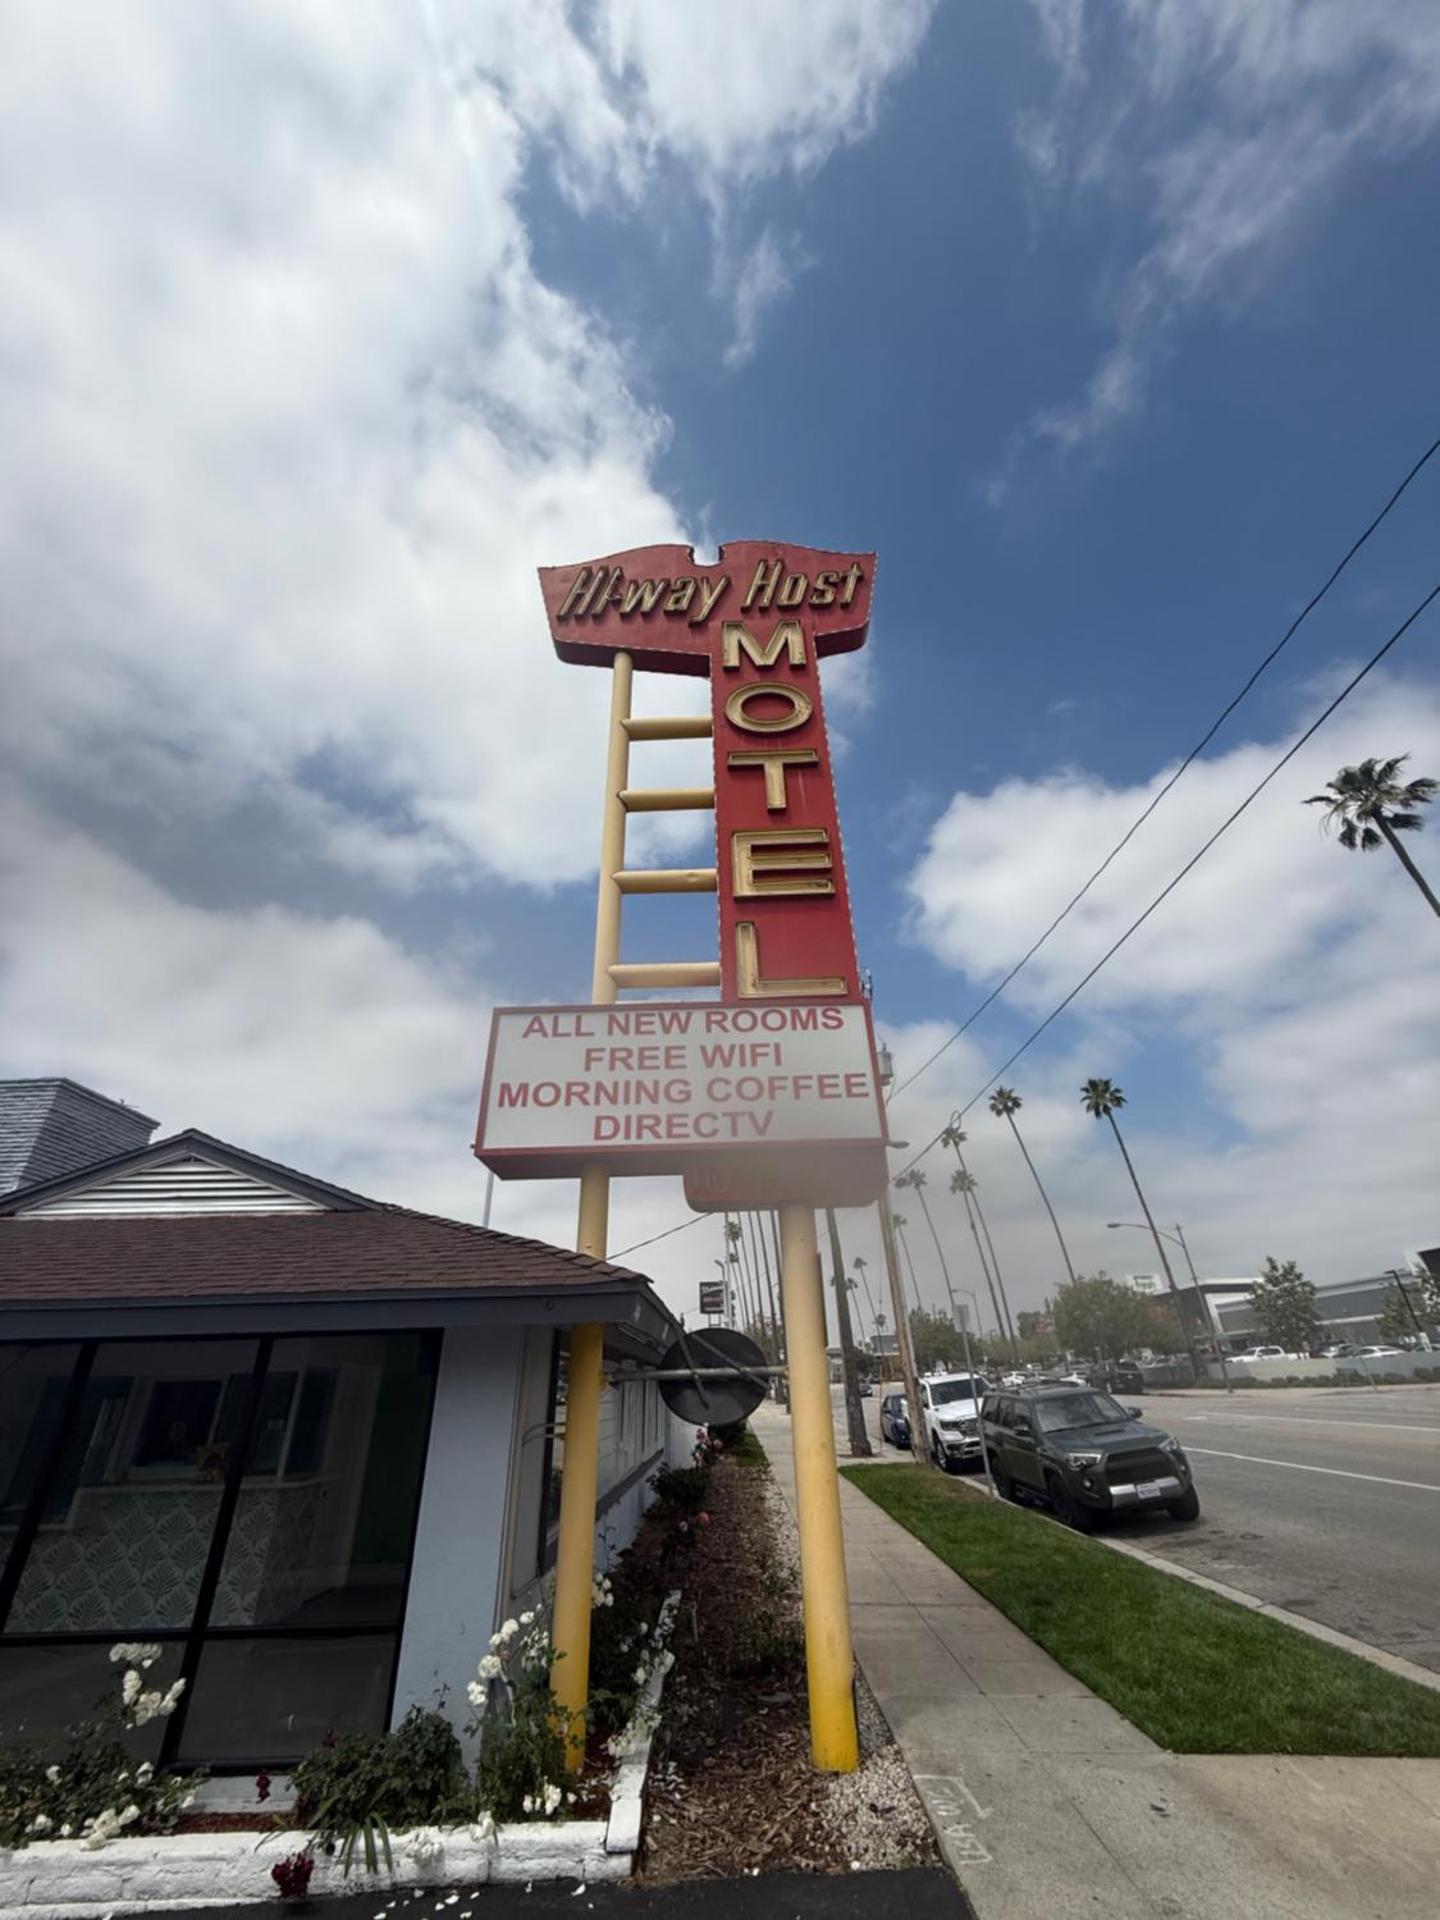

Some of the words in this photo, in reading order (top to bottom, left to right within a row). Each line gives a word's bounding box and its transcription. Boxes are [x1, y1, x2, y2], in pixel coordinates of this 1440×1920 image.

[740, 558, 864, 613] Host
[721, 619, 850, 1000] MOTEL
[522, 1013, 595, 1039] ALL
[607, 1011, 692, 1036] NEW
[705, 1007, 844, 1034] ROOMS
[584, 1045, 687, 1072] FREE
[700, 1042, 783, 1069] WIFI
[498, 1079, 692, 1108] MORNING
[706, 1073, 870, 1103] COFFEE
[594, 1110, 775, 1141] DIRECTV
